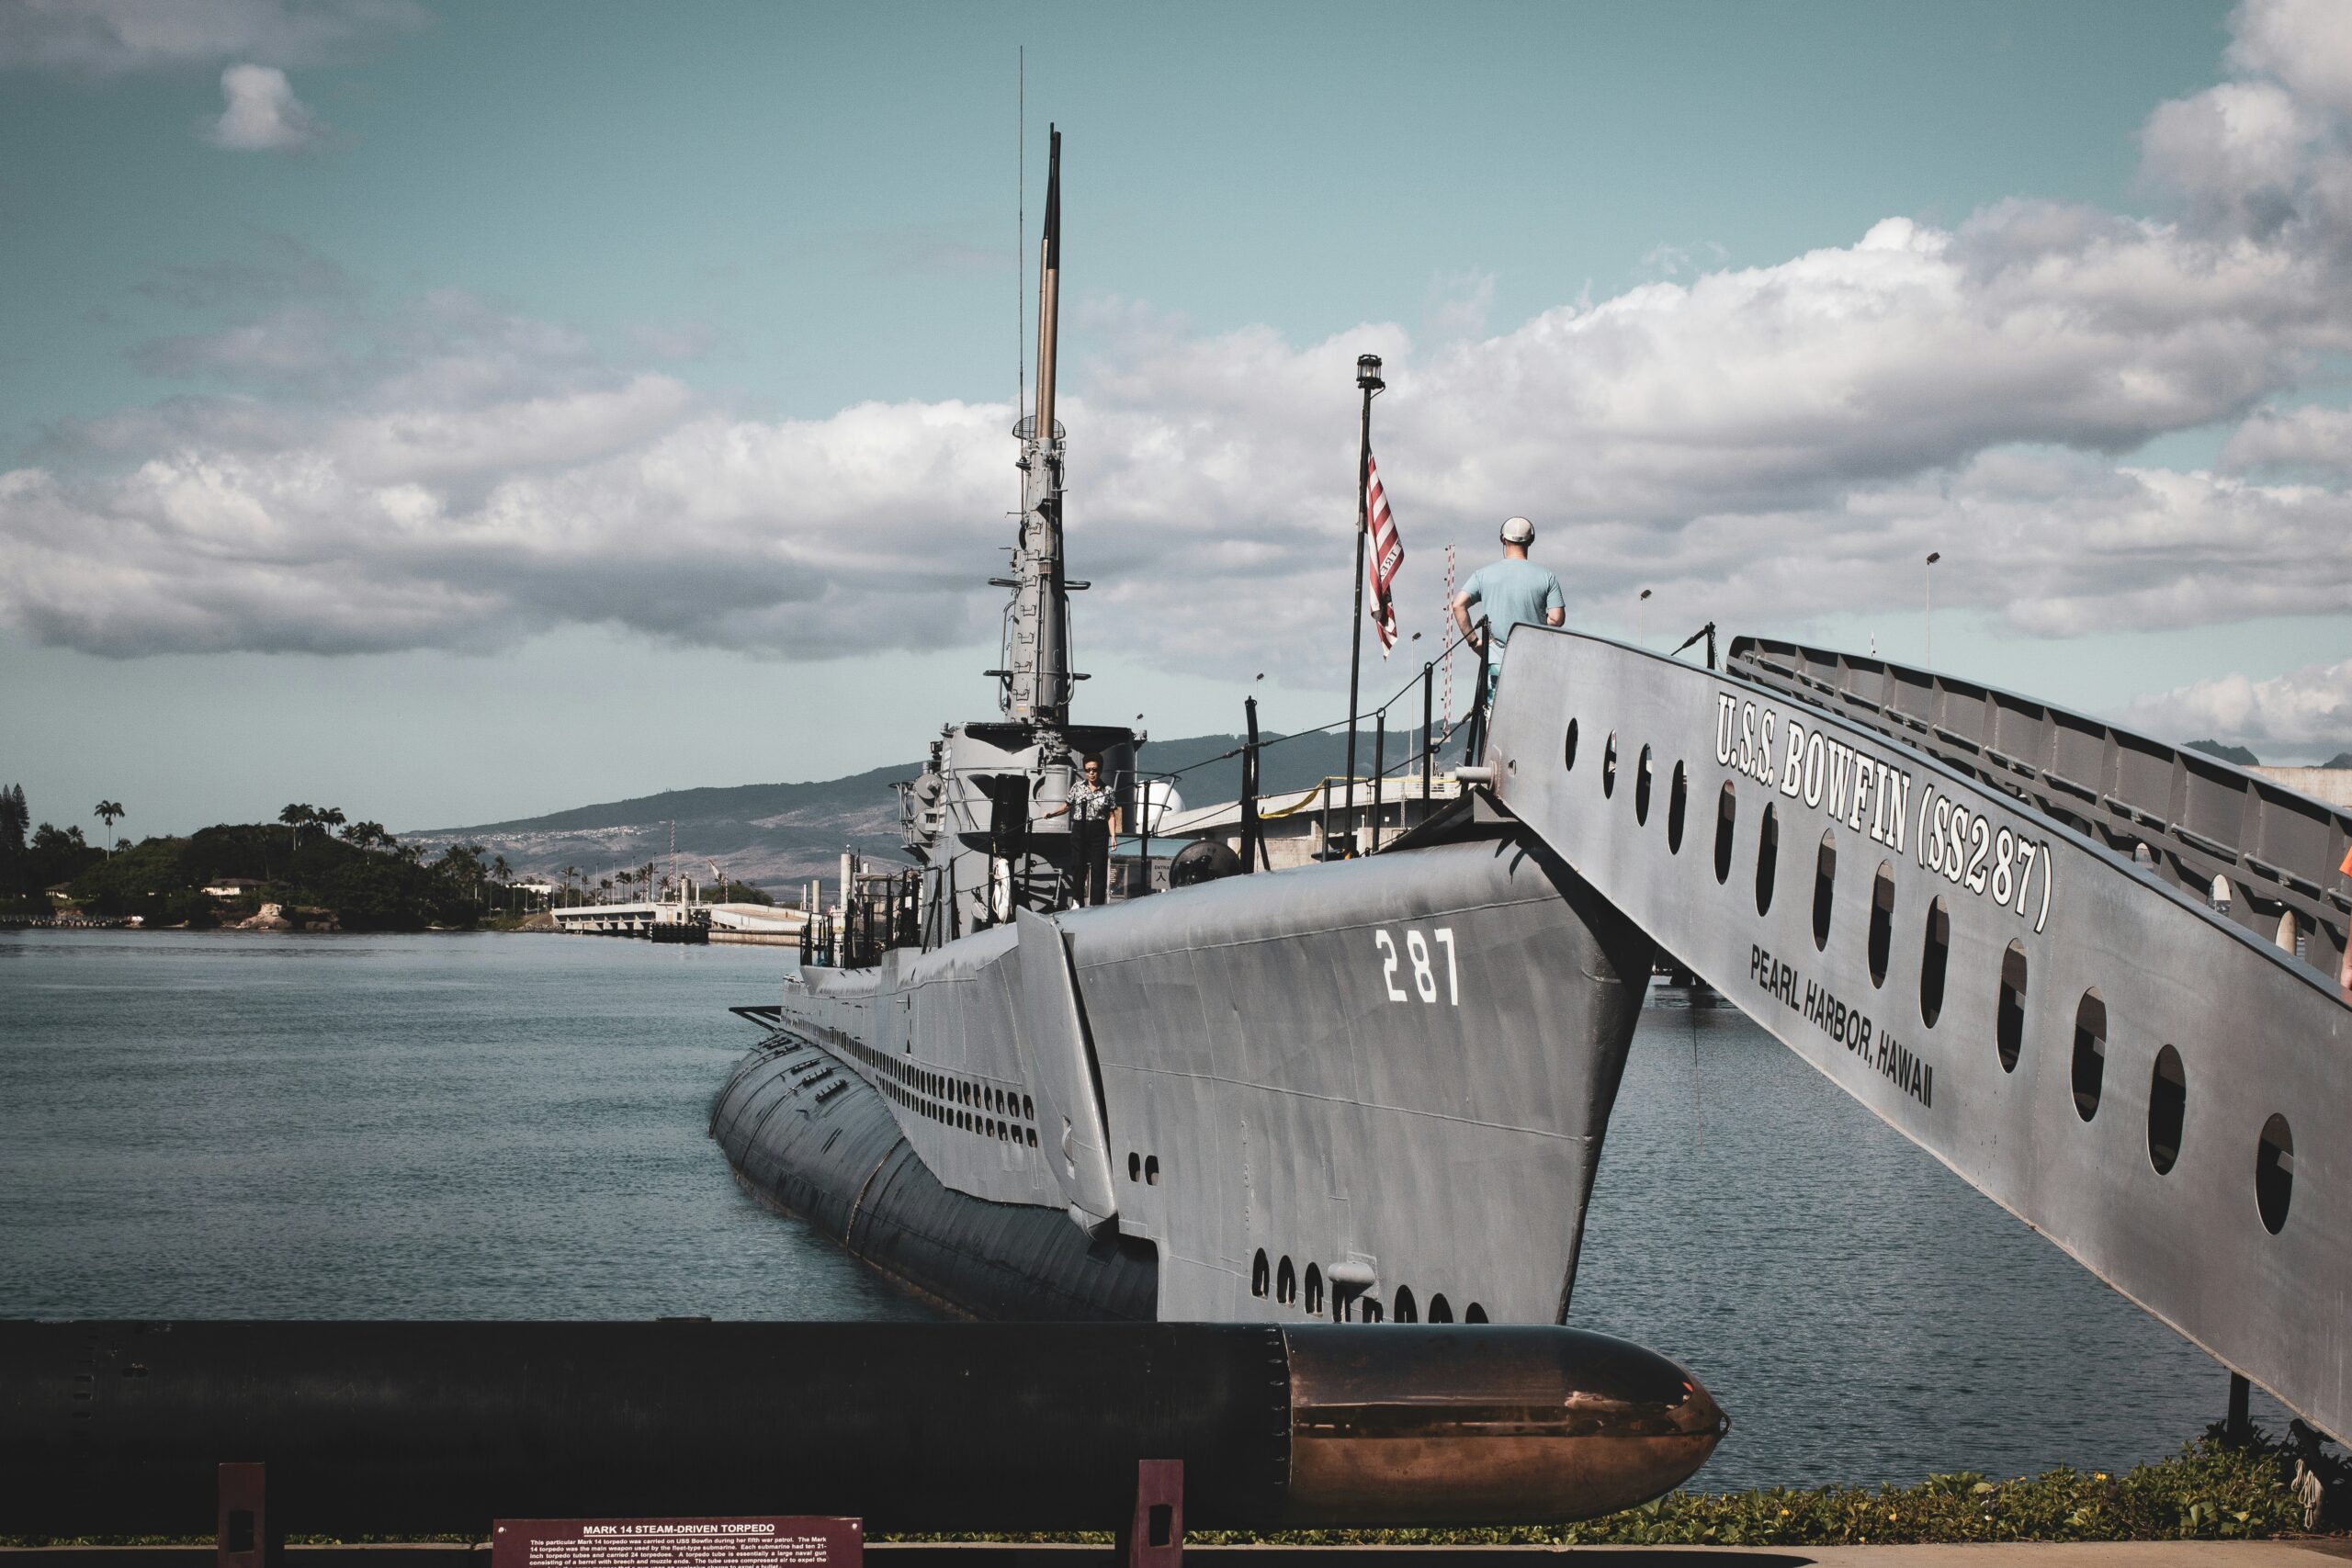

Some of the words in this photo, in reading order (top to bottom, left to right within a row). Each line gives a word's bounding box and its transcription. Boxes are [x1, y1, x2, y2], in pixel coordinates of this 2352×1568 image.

[1715, 693, 1776, 786] U.S.S.
[1780, 720, 1911, 854] BOWFIN
[1917, 783, 2053, 934] (SS287)
[1375, 928, 1458, 1006] 287
[1751, 943, 1800, 1013] PEARL
[1804, 978, 1872, 1068] HARBOR,
[1877, 1034, 1933, 1109] HAWAII
[583, 1526, 616, 1534] MARK
[635, 1525, 718, 1533] STEAM-DRIVEN
[721, 1524, 775, 1532] TORPEDO
